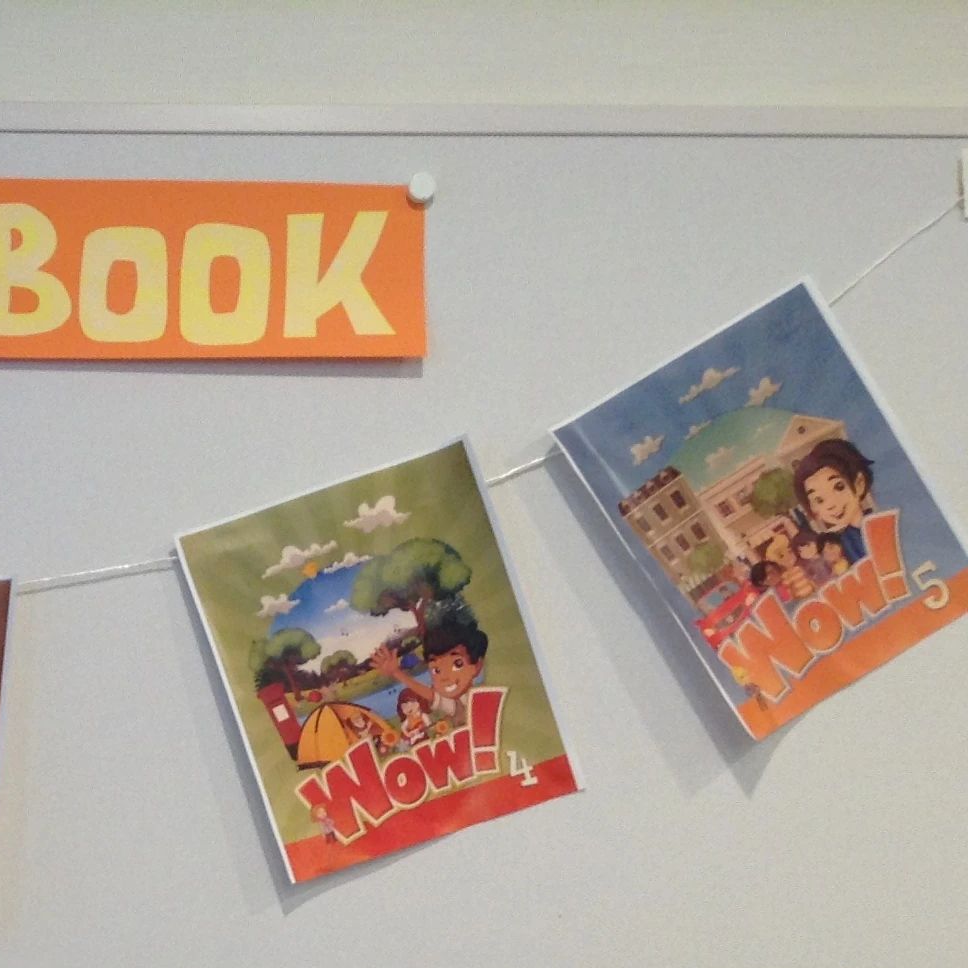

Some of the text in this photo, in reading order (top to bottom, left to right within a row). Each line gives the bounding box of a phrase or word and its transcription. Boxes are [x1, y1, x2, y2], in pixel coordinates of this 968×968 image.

[717, 507, 952, 701] Wow! 5
[297, 687, 538, 842] Wow! 4
